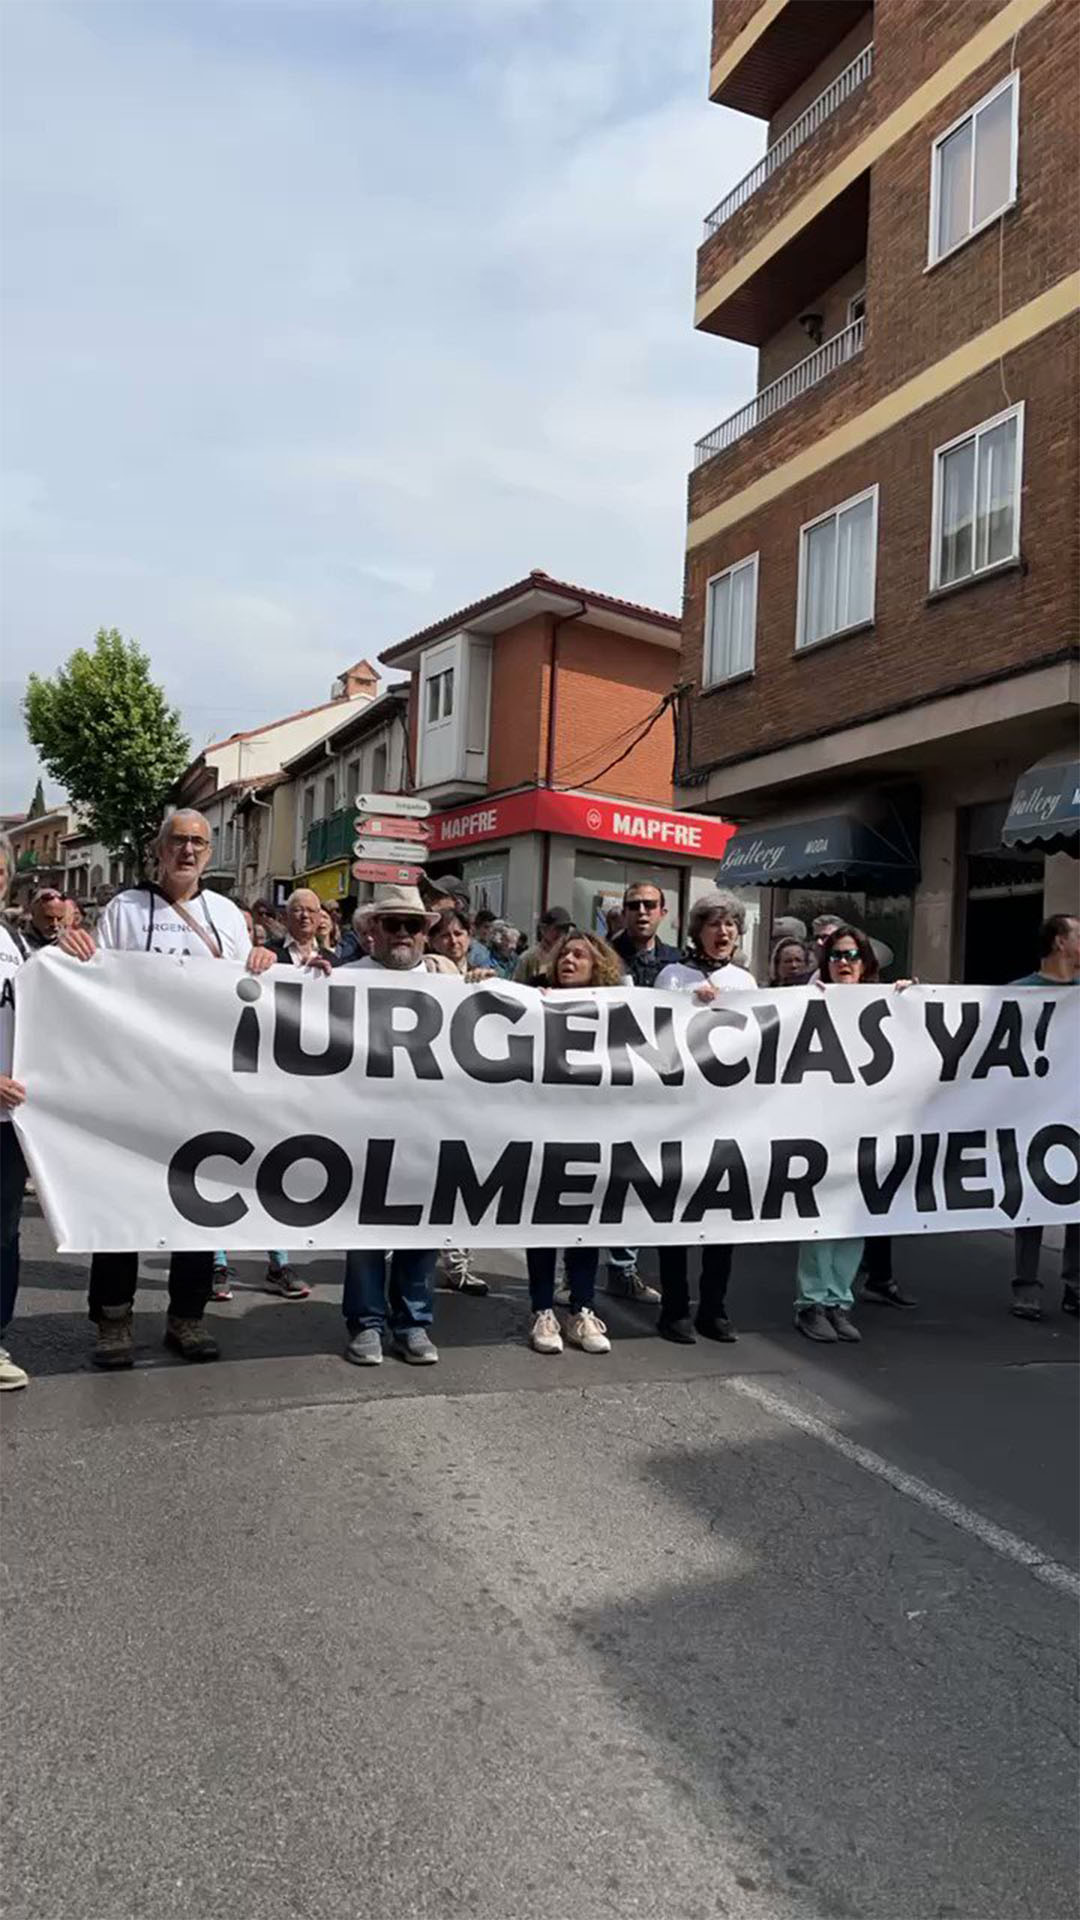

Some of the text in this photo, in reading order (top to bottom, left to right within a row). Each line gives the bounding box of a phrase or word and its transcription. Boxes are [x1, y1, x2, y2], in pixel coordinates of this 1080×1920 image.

[440, 808, 497, 841] MAPFRE
[612, 812, 702, 848] MAPFRE
[721, 838, 829, 871] Gallery MODA
[232, 977, 1056, 1087] ¡URGENCIAS YA!
[167, 1123, 1080, 1228] COLMENAR VIEJO
